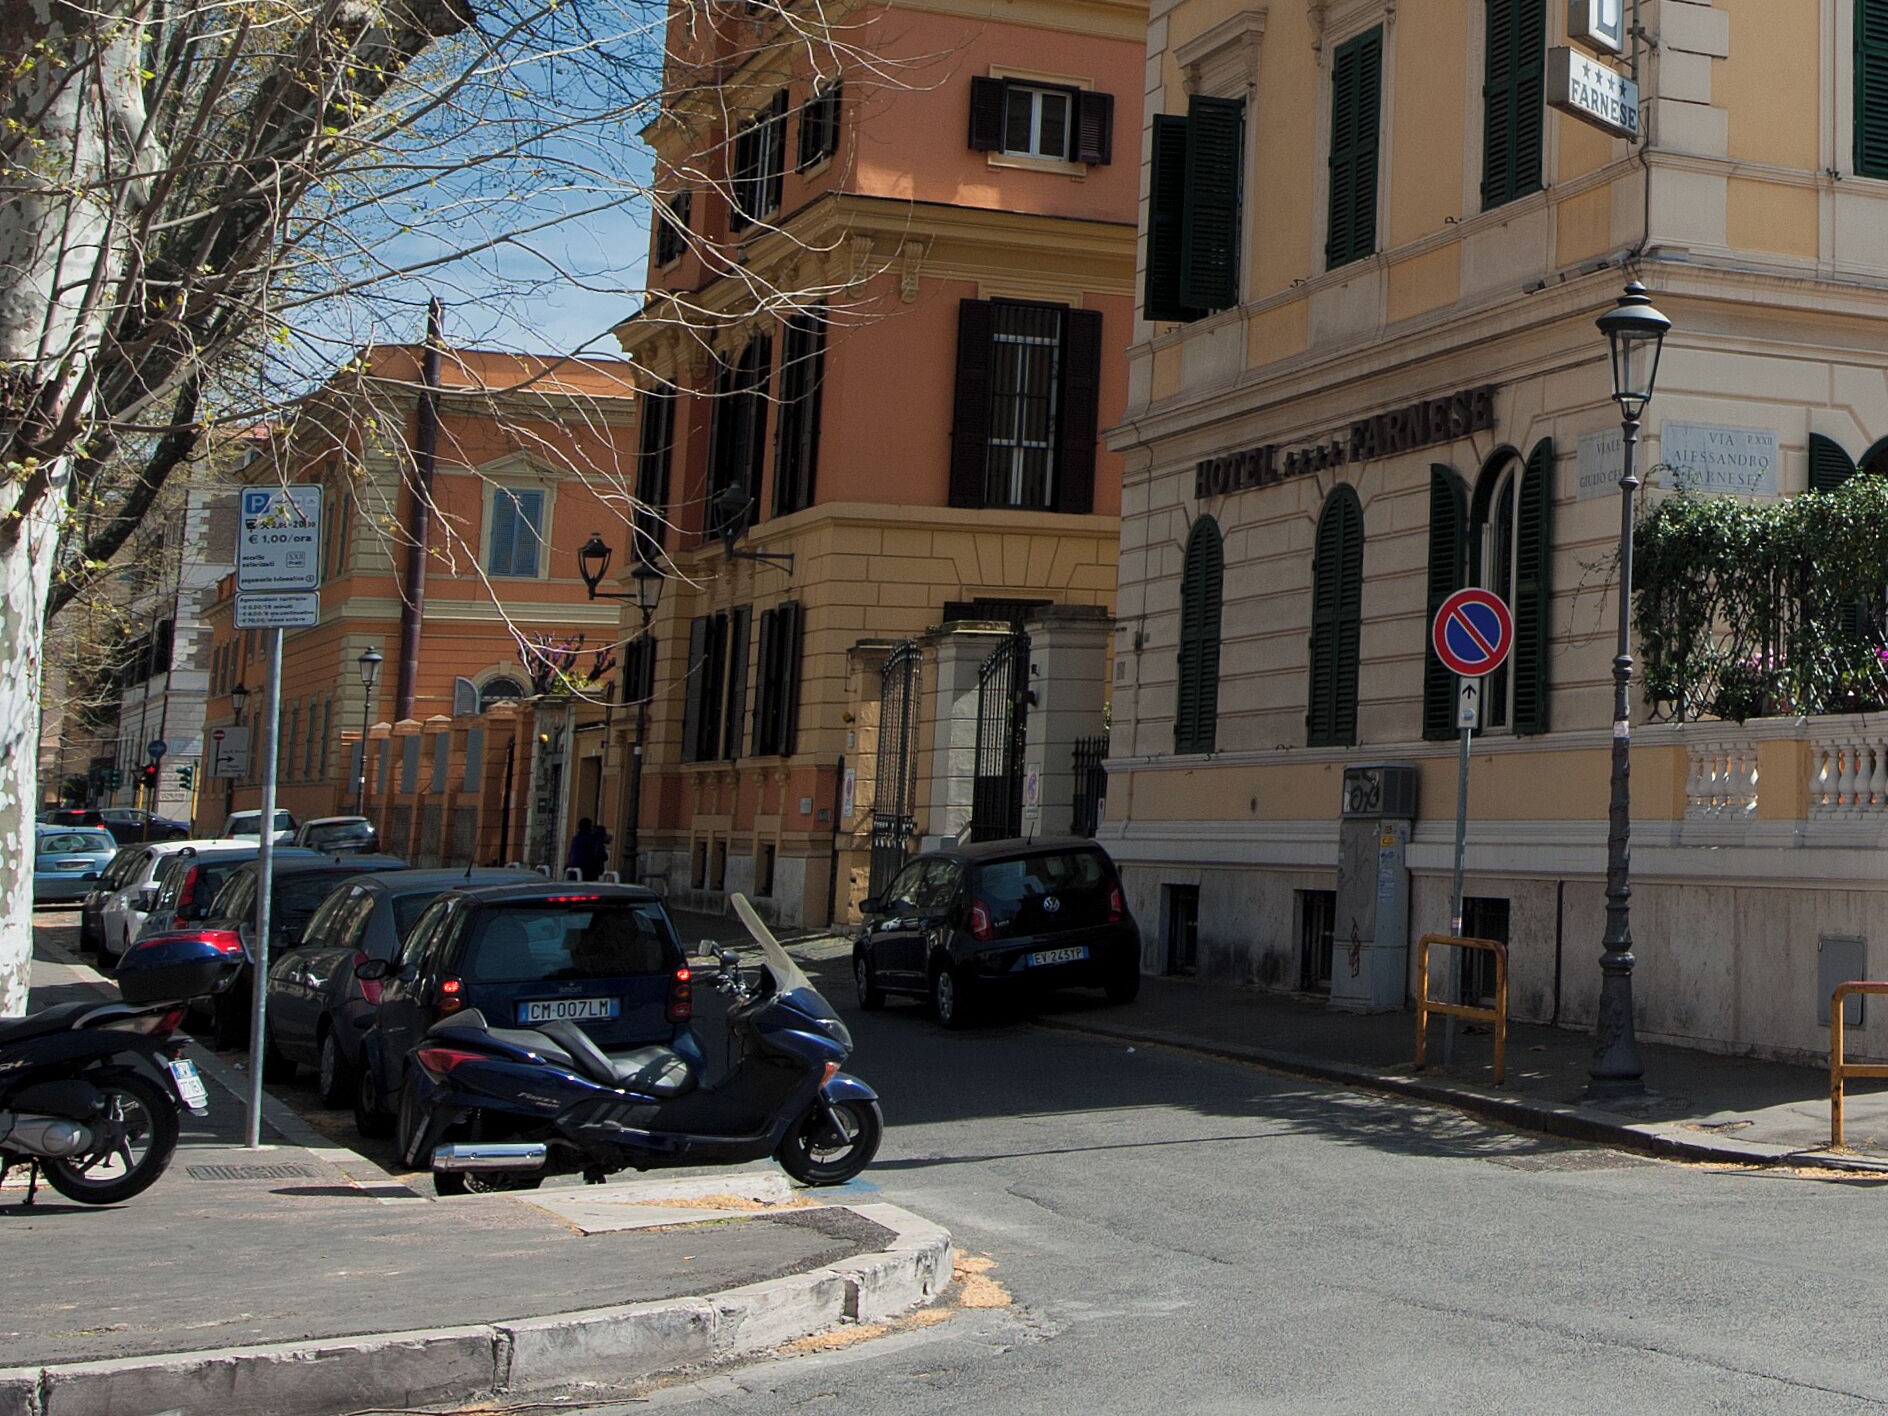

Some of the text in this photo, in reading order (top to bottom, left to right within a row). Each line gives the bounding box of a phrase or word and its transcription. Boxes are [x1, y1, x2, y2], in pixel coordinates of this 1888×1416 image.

[1571, 77, 1637, 131] FARNESE
[1195, 383, 1496, 499] HOTEL FARNESE
[1596, 439, 1620, 456] VIALE
[1709, 432, 1734, 446] VIA
[1673, 449, 1769, 468] ALESSANDRO
[251, 495, 265, 512] P
